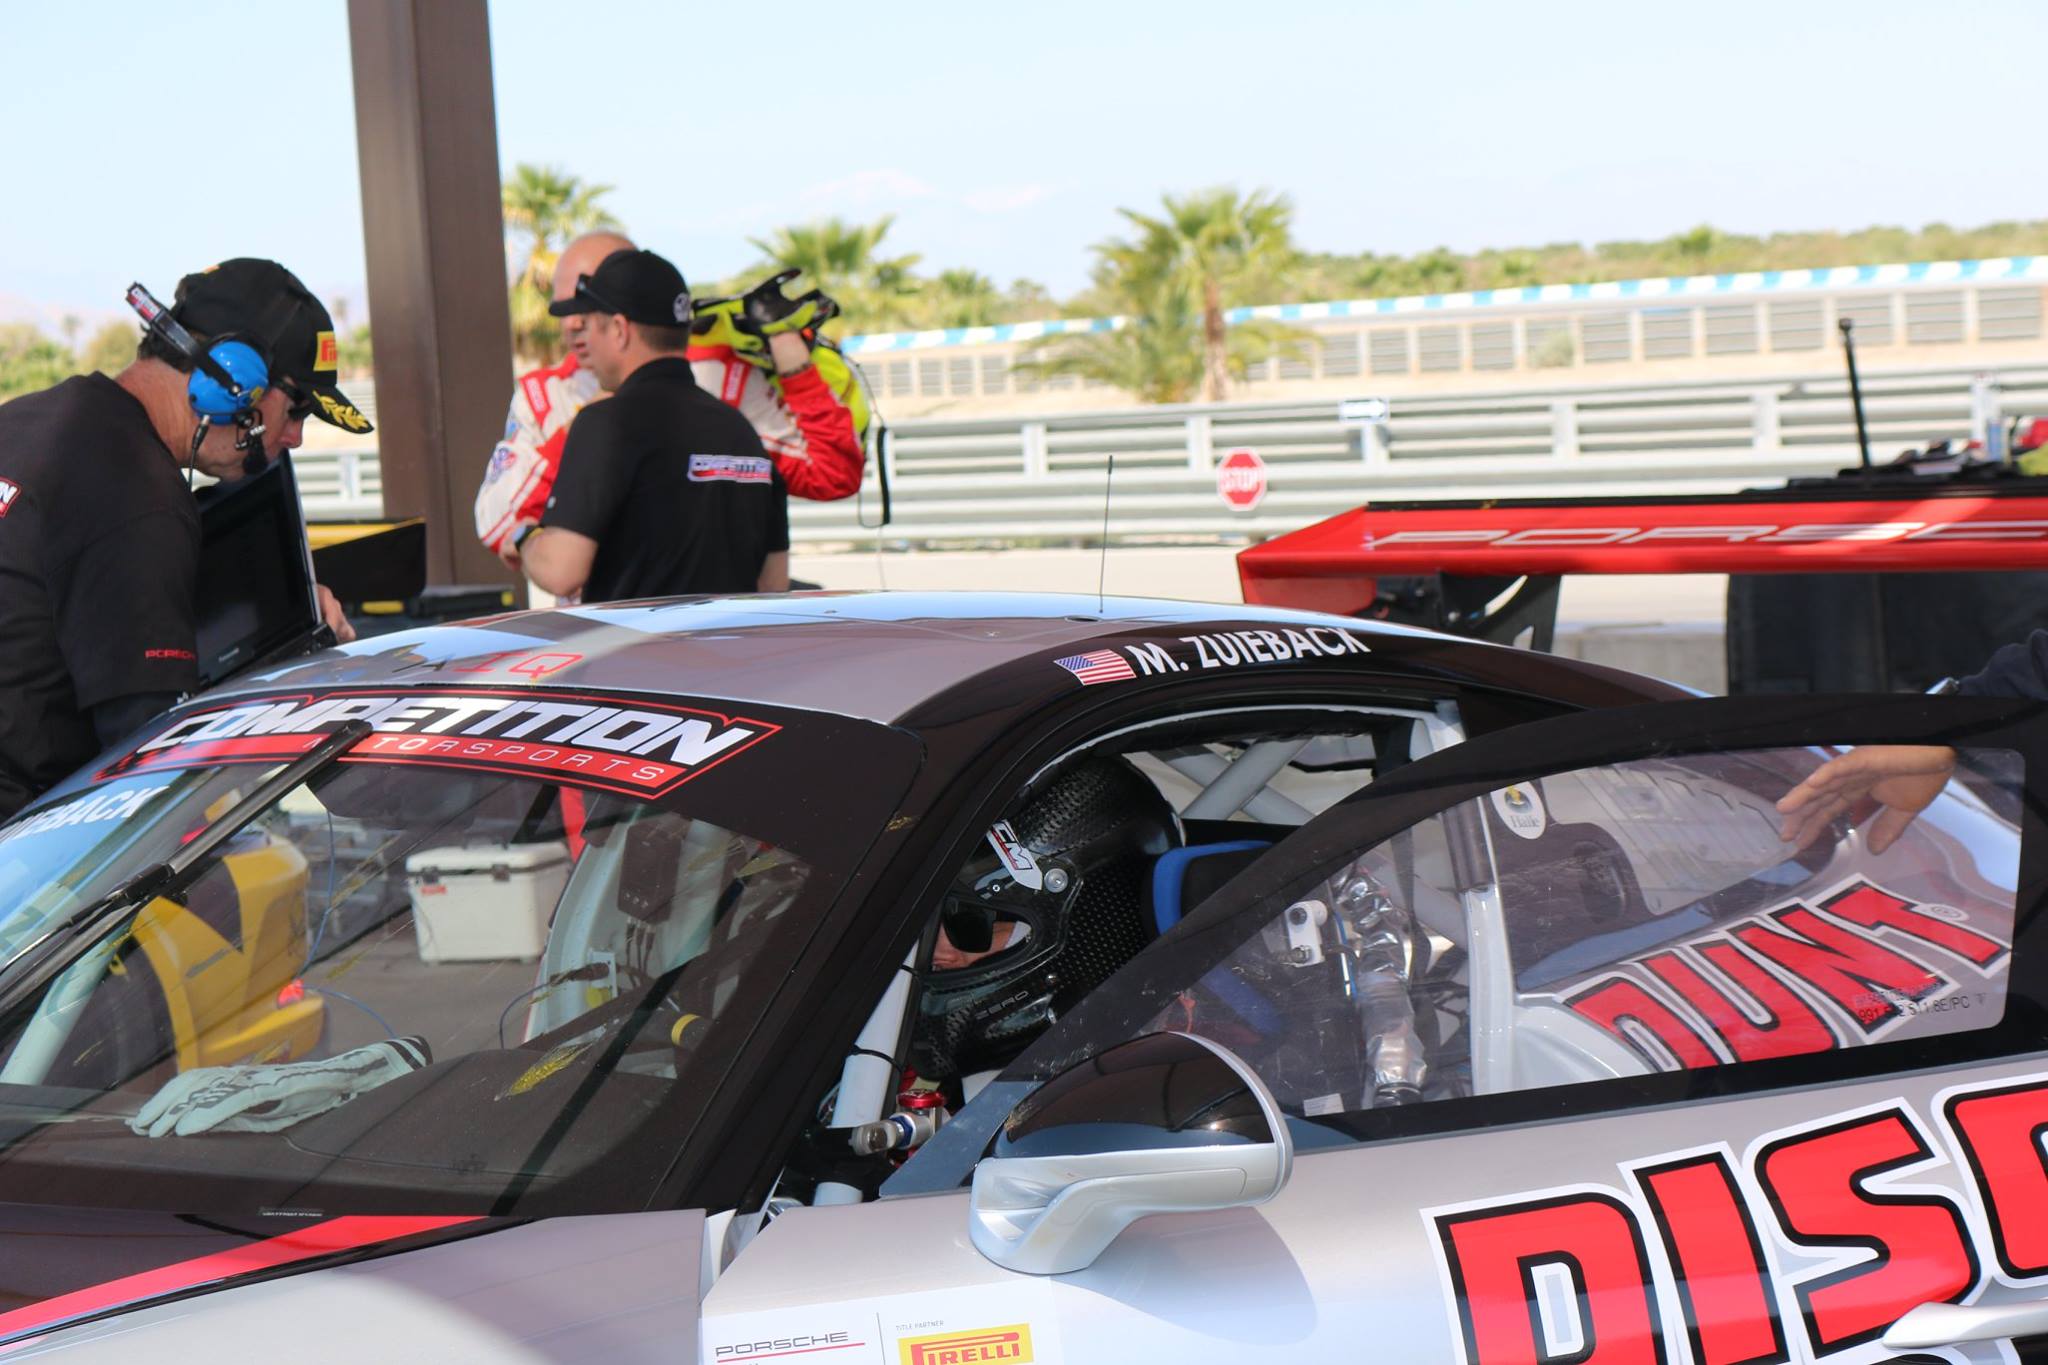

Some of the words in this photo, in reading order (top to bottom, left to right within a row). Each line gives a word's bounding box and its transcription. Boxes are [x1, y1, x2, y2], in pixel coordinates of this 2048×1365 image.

[1124, 642, 1189, 676] M.
[136, 697, 755, 766] COMPETITION
[715, 1331, 849, 1357] PORSCHE
[910, 1331, 1020, 1365] PIRELLI
